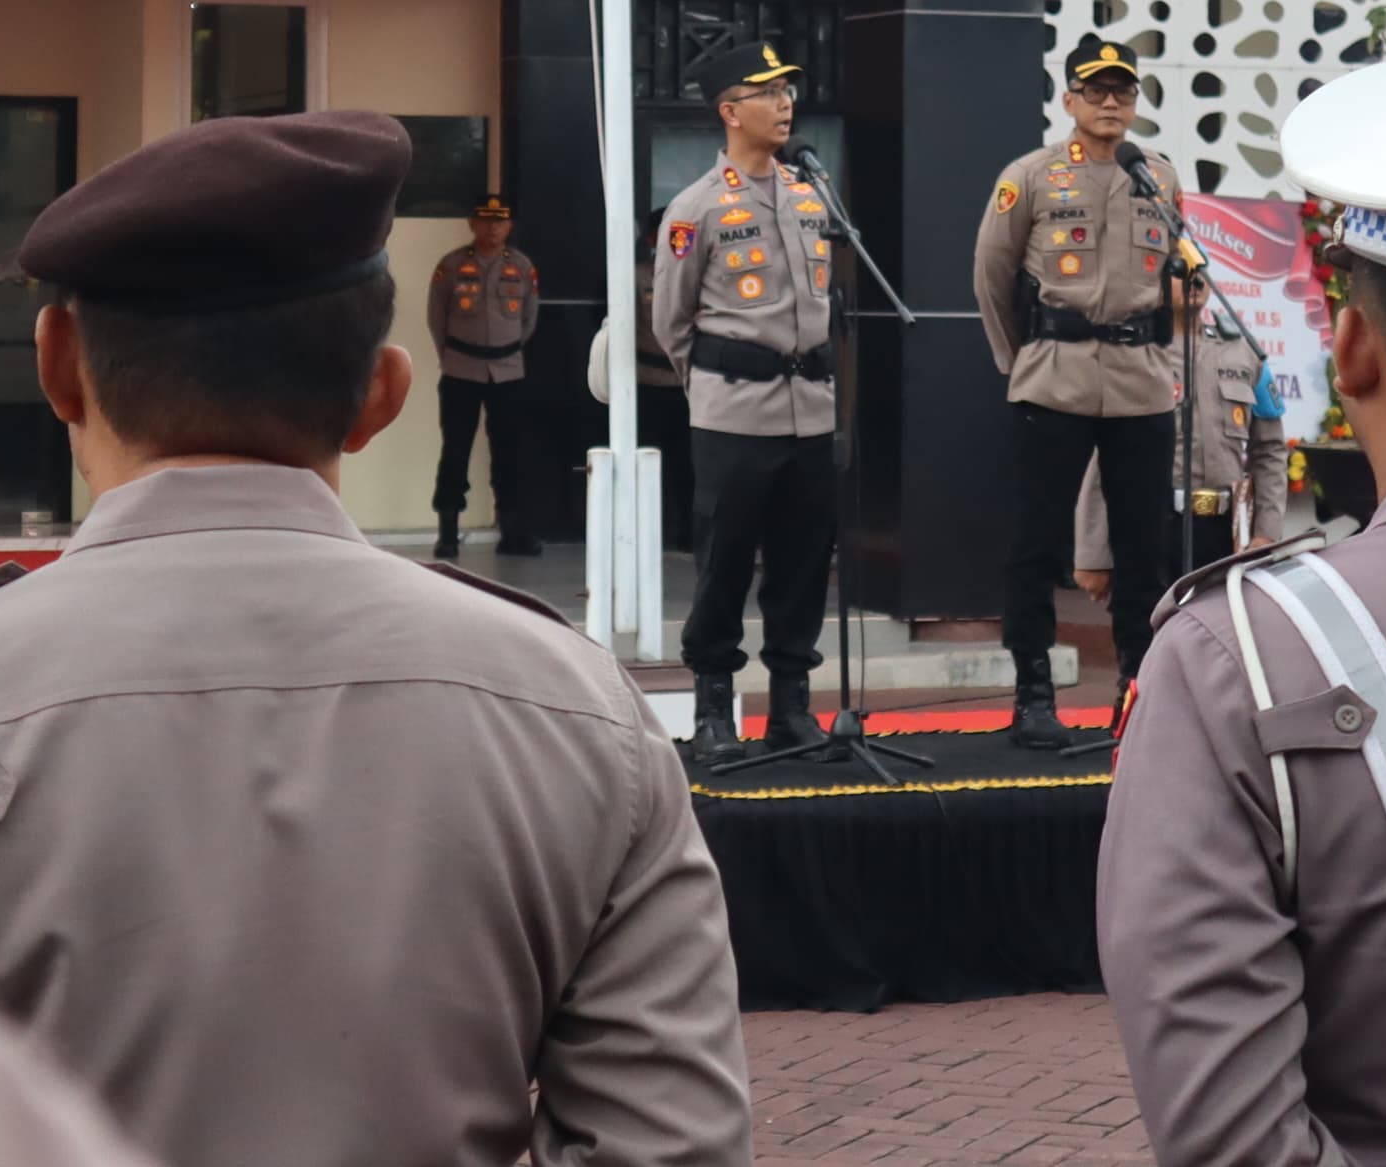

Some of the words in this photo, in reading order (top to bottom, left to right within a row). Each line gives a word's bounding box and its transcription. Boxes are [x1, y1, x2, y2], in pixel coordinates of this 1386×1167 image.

[1050, 209, 1086, 221] INDRA
[719, 226, 761, 244] MALIKI
[1187, 214, 1254, 260] Sukses
